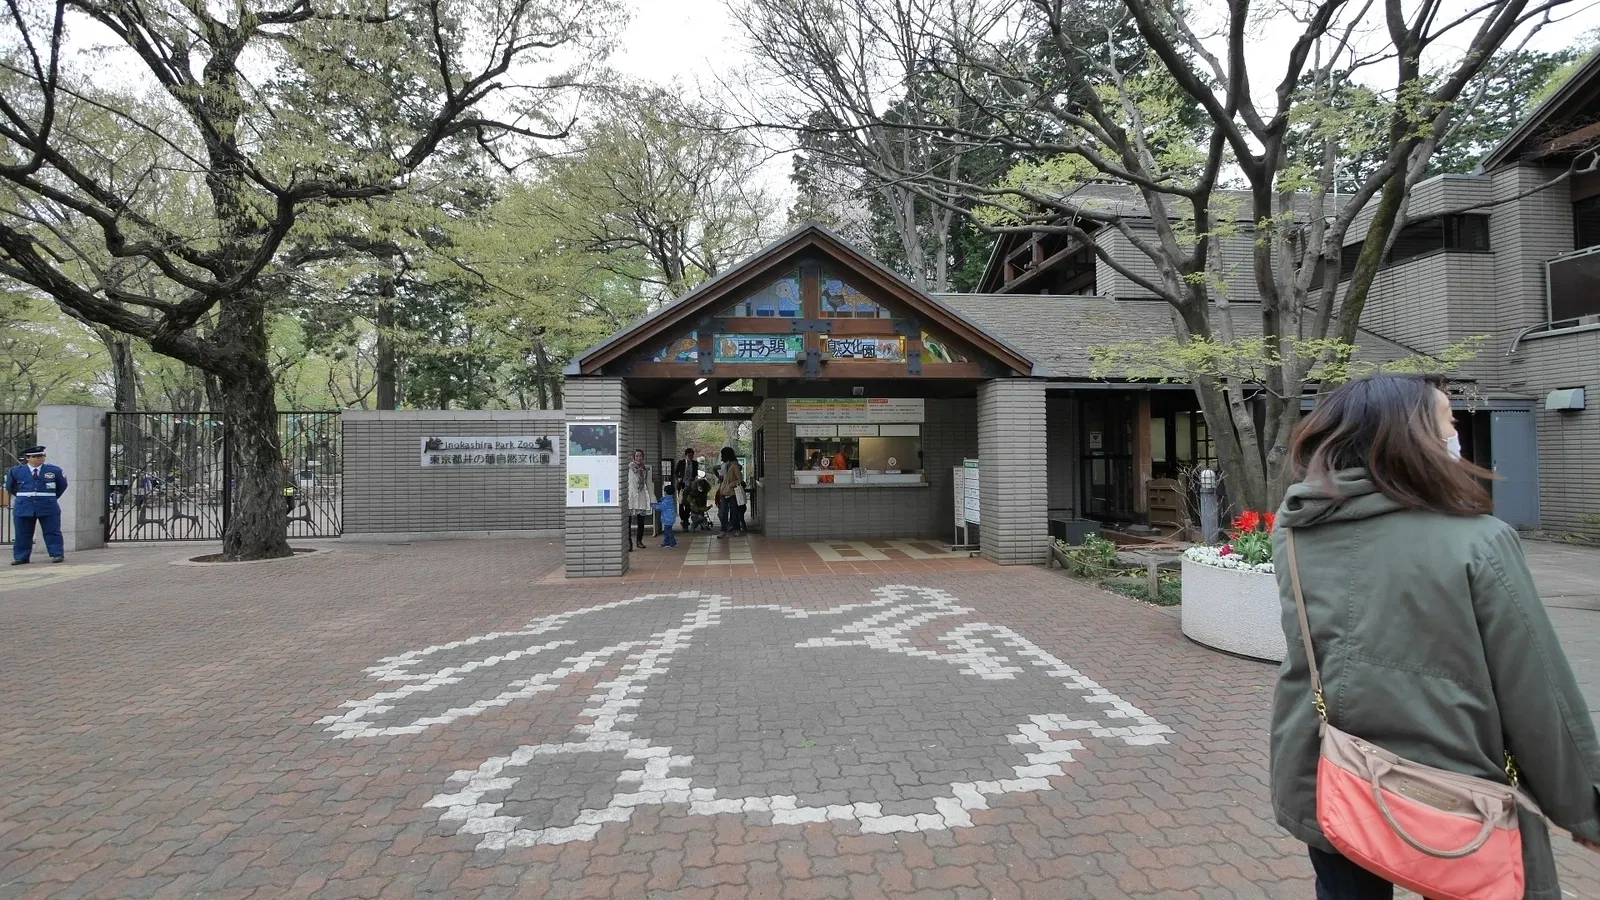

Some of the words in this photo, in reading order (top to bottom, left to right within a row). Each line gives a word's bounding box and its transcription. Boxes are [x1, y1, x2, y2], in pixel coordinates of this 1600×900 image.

[738, 338, 787, 358] 井の頭
[445, 440, 493, 450] Inokashira
[495, 440, 515, 450] Park
[517, 440, 535, 449] Zoo
[429, 453, 550, 465] 東京都井の頭自然文化園
